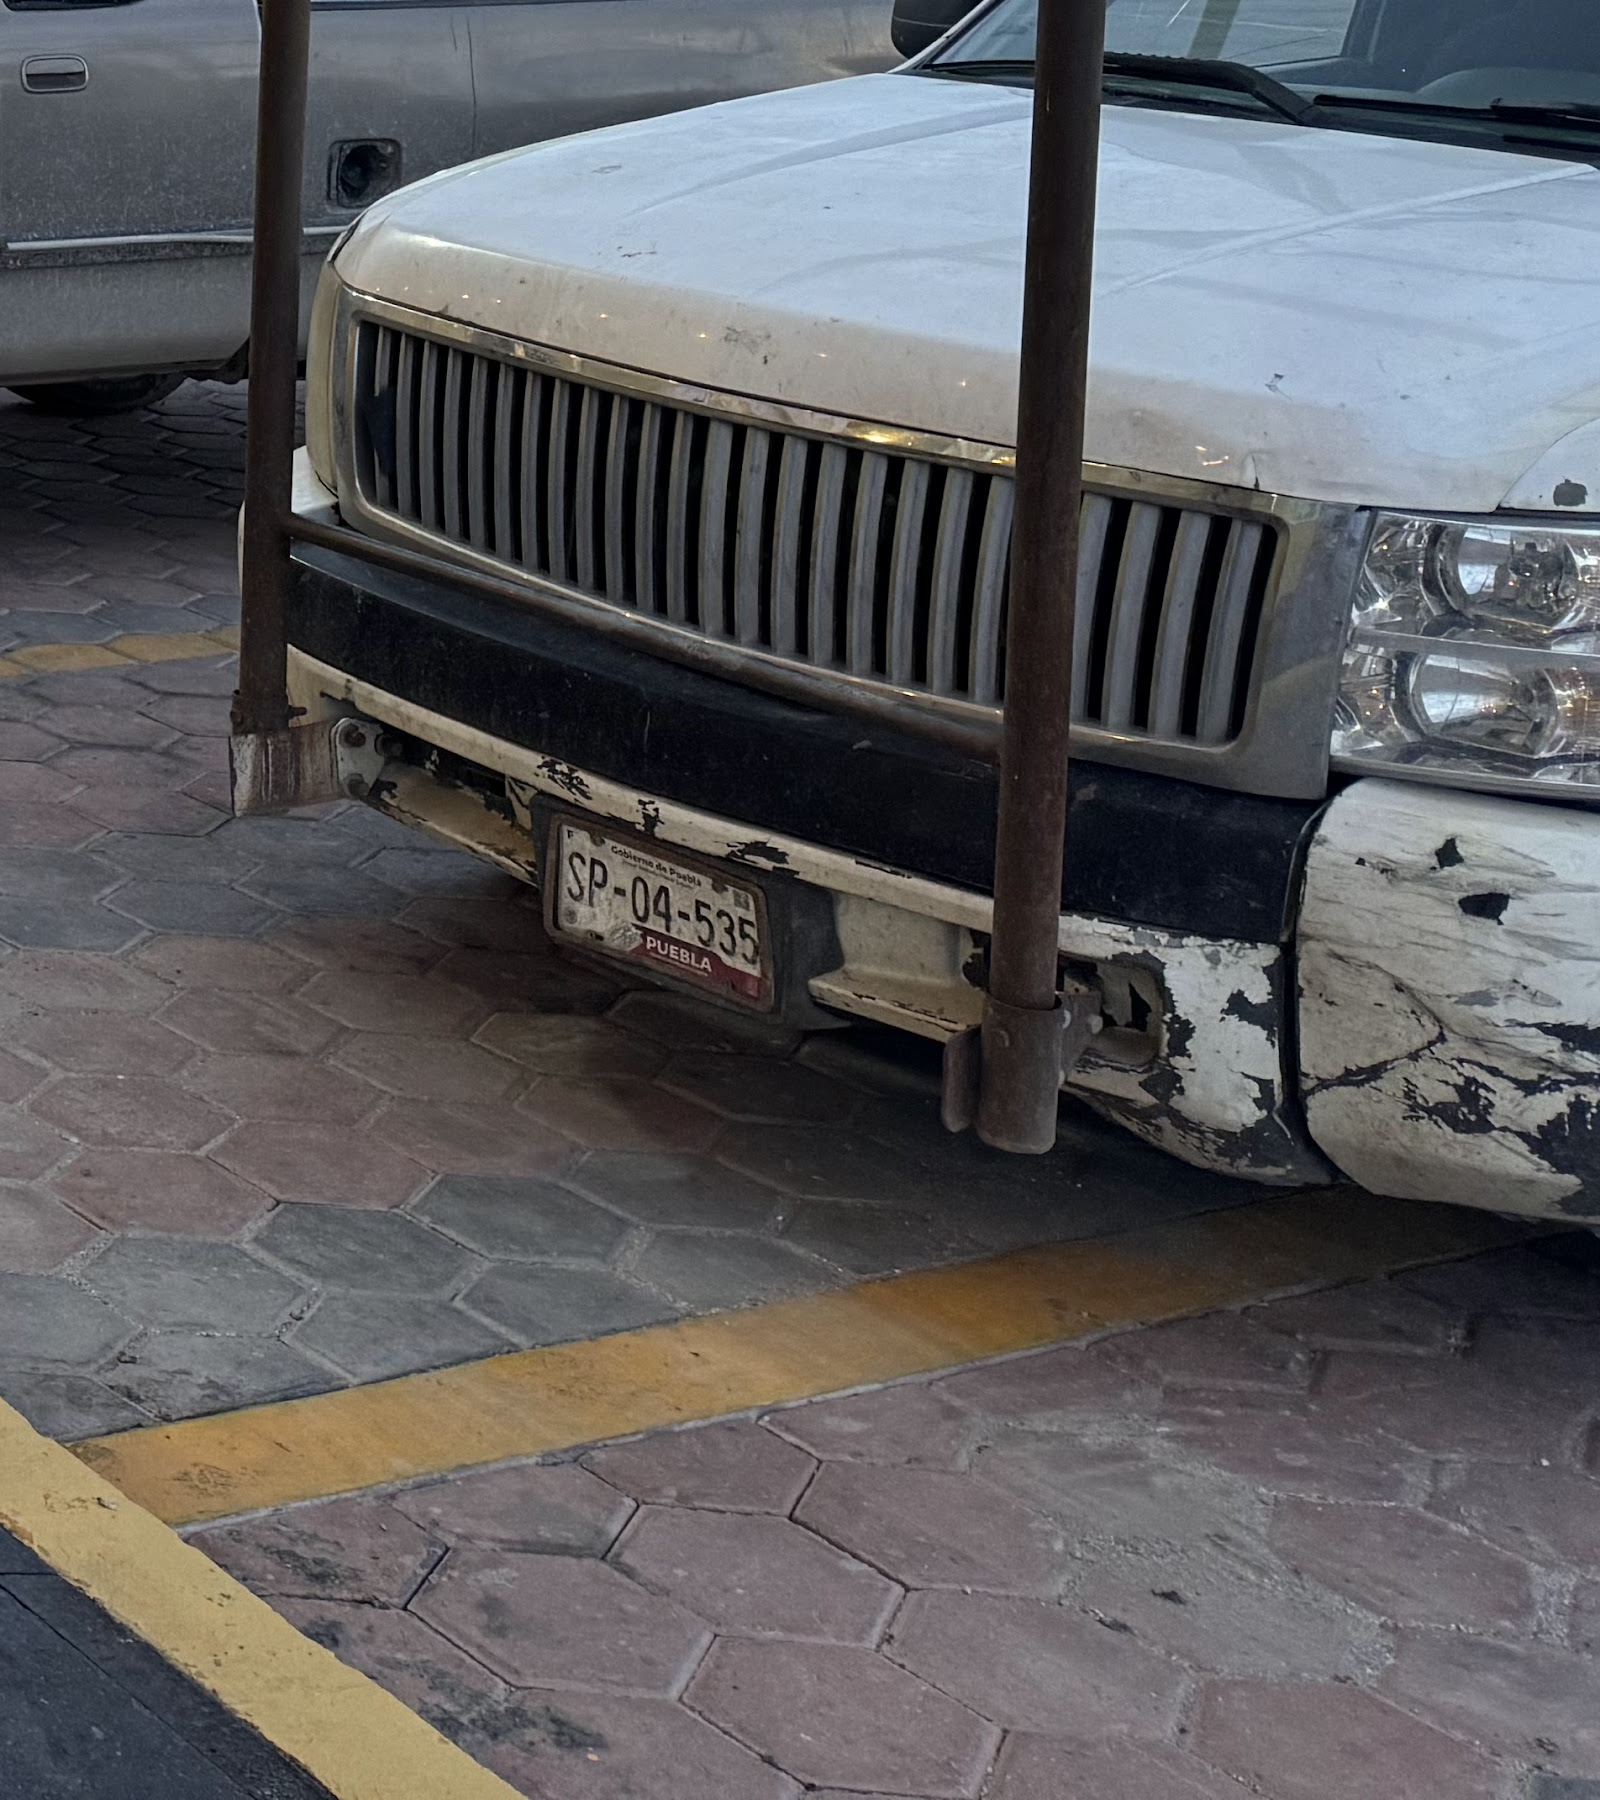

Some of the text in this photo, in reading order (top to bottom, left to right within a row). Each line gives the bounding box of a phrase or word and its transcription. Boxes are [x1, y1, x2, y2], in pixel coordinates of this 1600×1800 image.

[611, 845, 654, 869] Gobierno
[655, 862, 668, 874] de
[669, 867, 702, 887] Puebla
[566, 851, 760, 966] SP-04-535
[645, 935, 713, 973] PUEBLA
